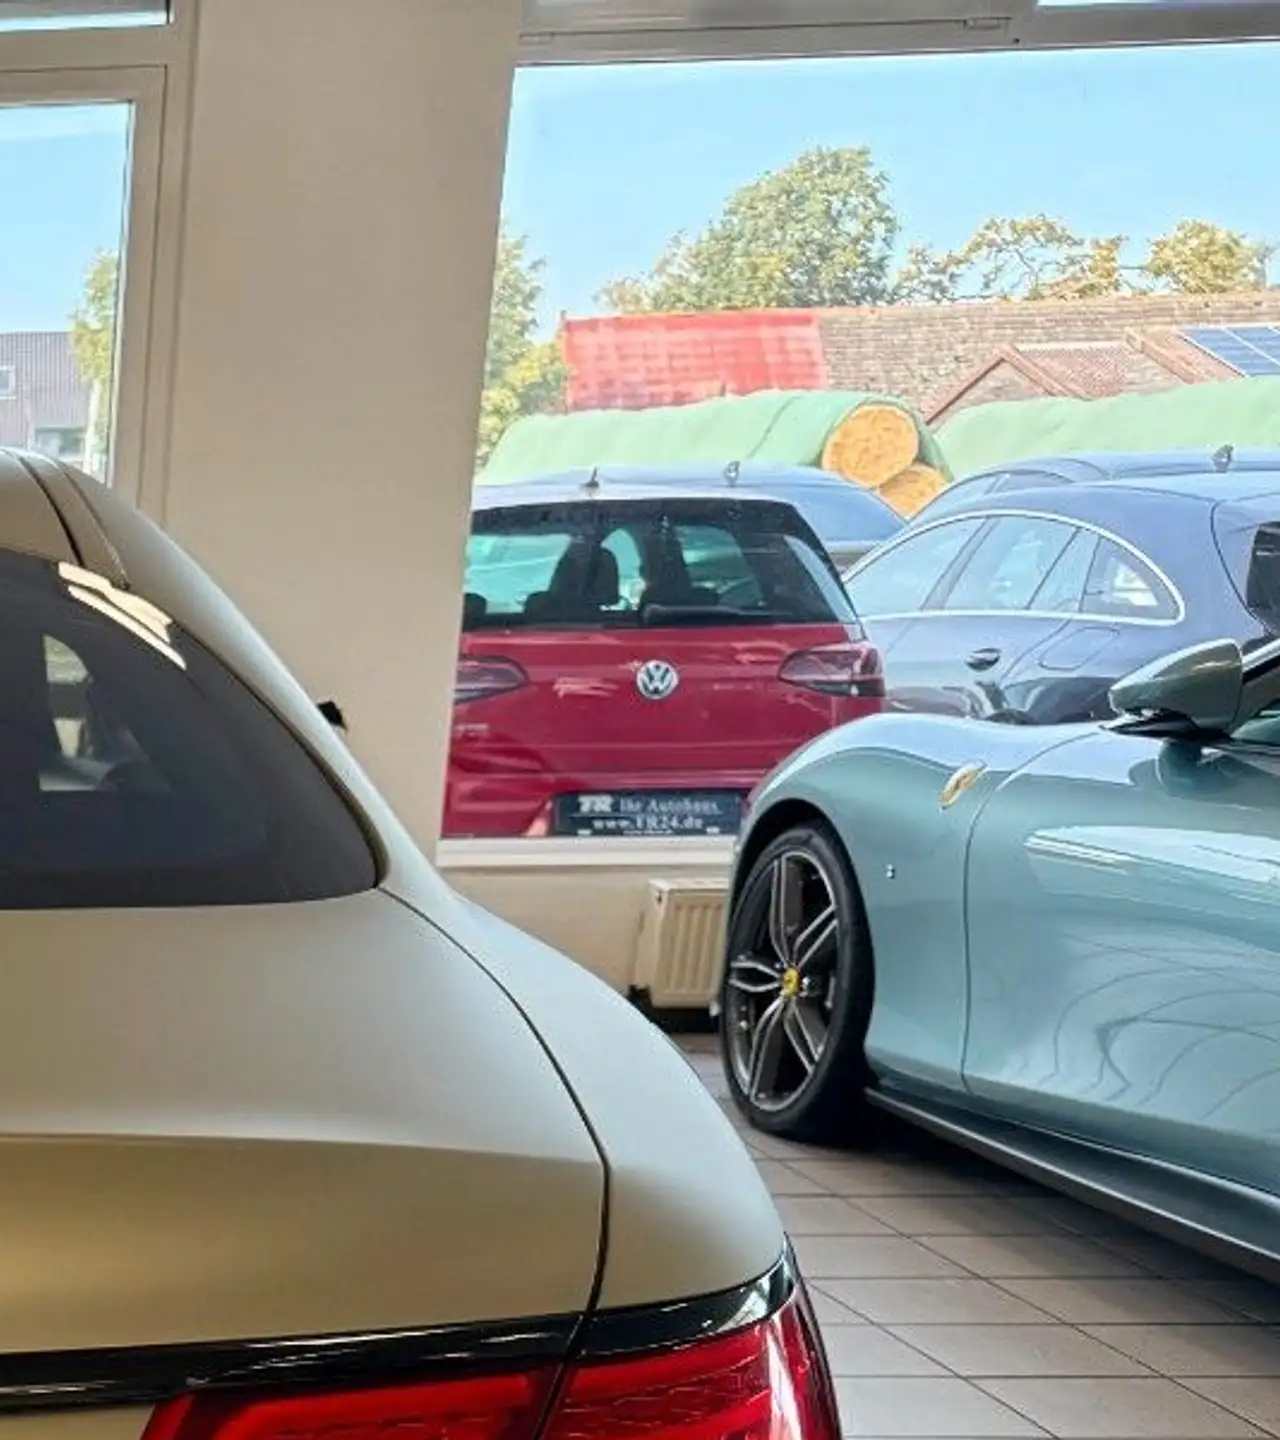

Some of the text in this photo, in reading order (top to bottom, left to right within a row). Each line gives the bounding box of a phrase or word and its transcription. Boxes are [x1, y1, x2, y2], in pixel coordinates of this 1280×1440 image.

[620, 797, 642, 814] Ihr
[647, 797, 724, 816] Autohaus
[592, 814, 704, 830] www.TR24.de
